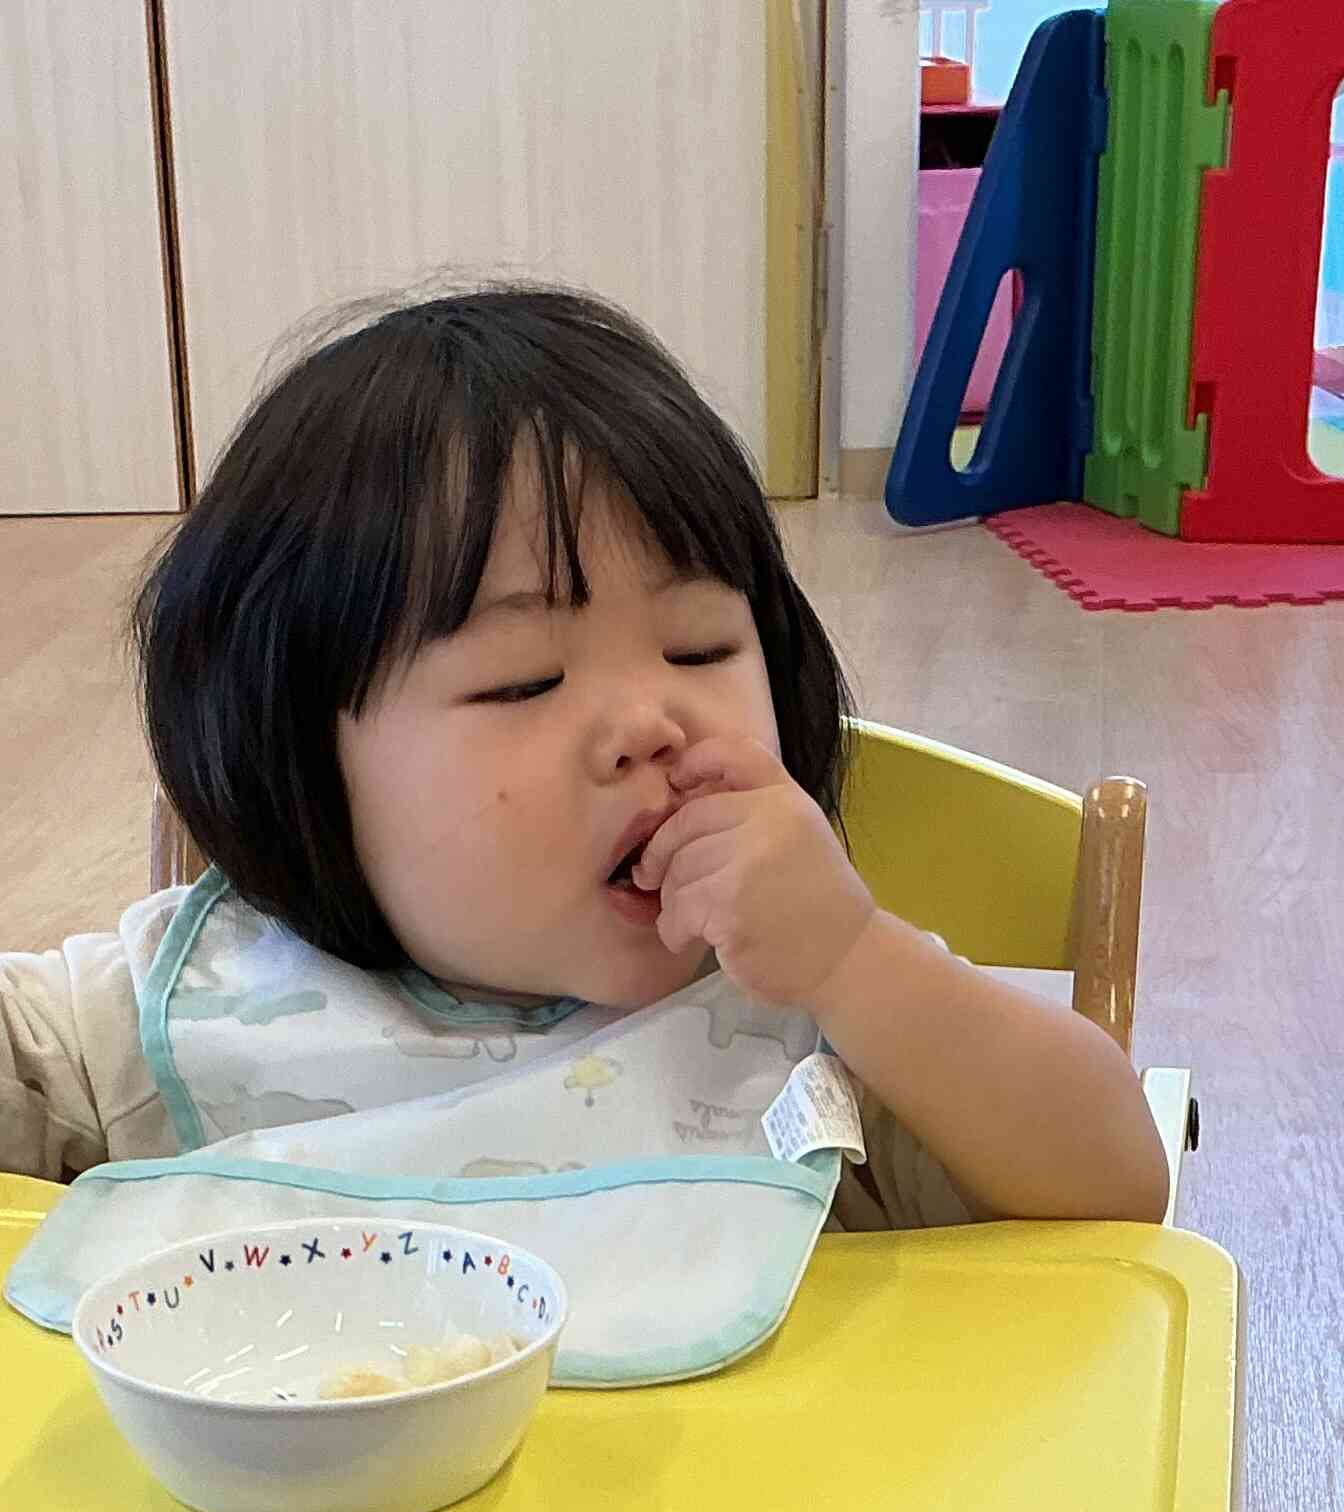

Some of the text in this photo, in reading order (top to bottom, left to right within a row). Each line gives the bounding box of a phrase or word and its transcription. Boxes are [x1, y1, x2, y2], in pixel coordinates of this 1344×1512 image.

[128, 1291, 141, 1312] T
[164, 1286, 180, 1308] U
[199, 1249, 214, 1272] V
[243, 1245, 269, 1267] W
[301, 1237, 325, 1264] X
[362, 1231, 377, 1252] Y
[398, 1231, 419, 1255] Z
[462, 1252, 476, 1275] A
[517, 1284, 529, 1303] C
